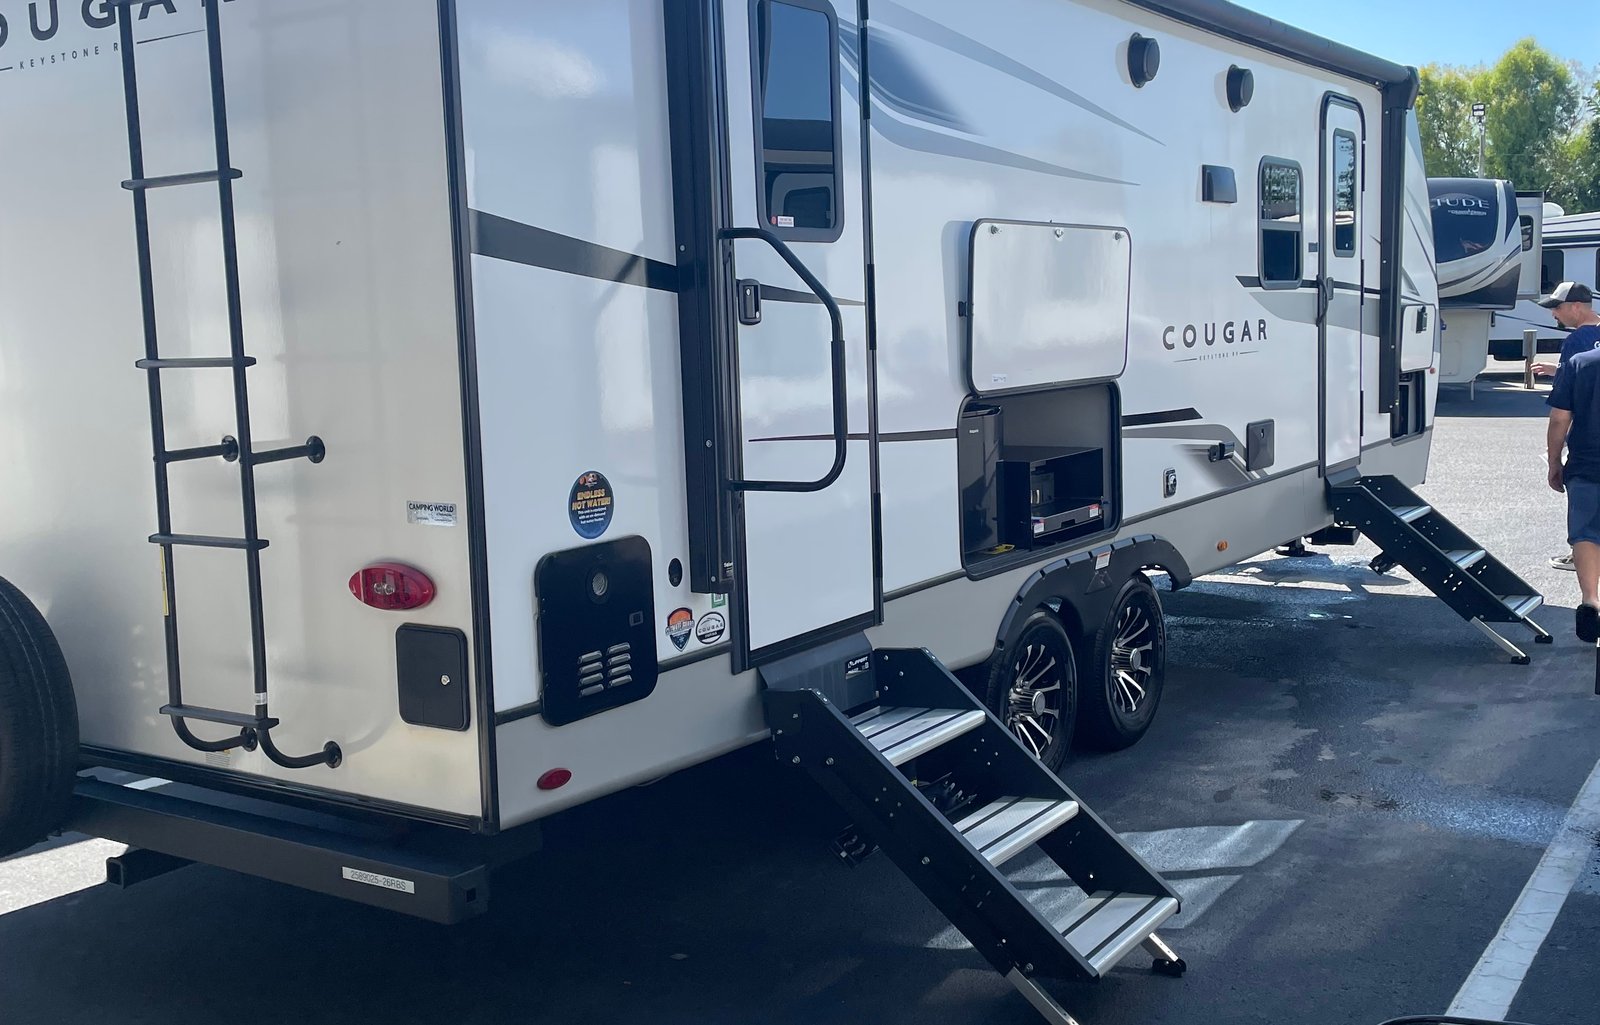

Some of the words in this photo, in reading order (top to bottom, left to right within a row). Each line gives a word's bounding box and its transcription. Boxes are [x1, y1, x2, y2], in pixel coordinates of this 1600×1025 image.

[19, 46, 100, 70] KEYSTONE
[1432, 198, 1490, 208] TUDE
[1162, 319, 1267, 350] COUGAR
[577, 489, 605, 500] ENDLESS
[408, 503, 433, 511] CAMPING
[572, 501, 585, 510] HOT
[698, 624, 724, 633] COUGAR
